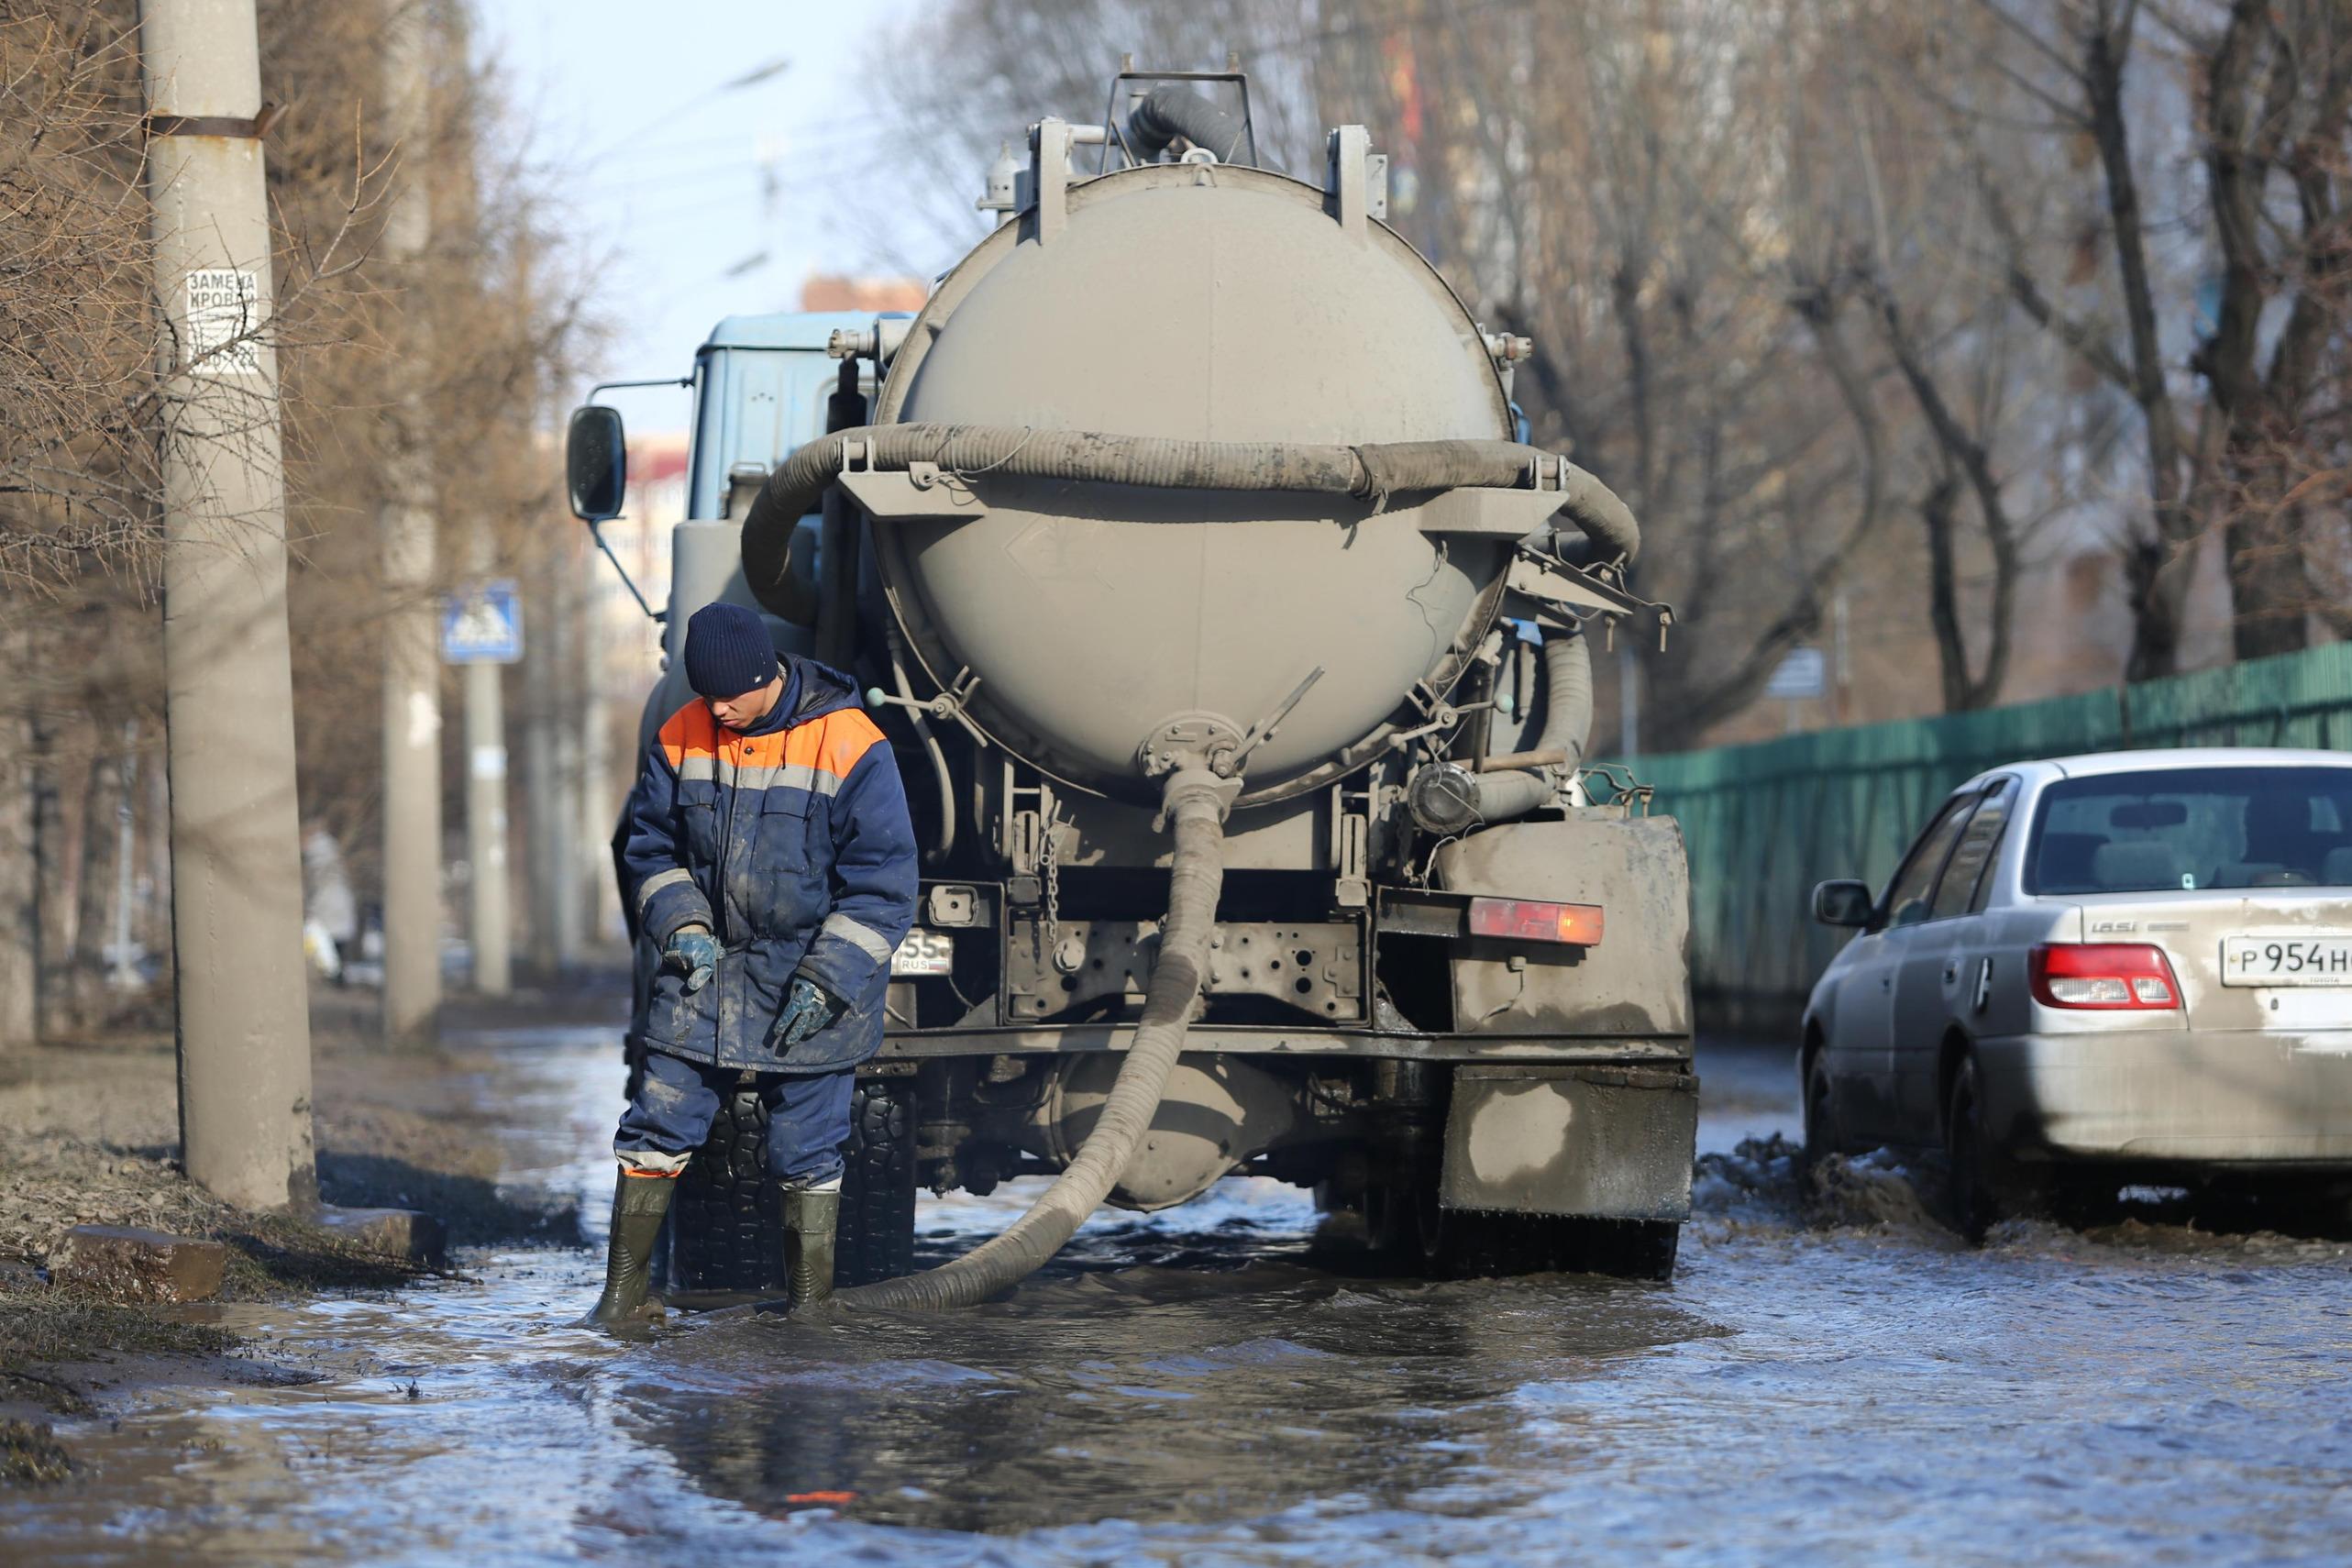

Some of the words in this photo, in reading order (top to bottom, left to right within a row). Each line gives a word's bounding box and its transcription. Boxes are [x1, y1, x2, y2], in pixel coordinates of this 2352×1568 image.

[190, 274, 255, 290] ЗАМЕНА
[905, 933, 937, 958] 55
[901, 960, 927, 969] RUS
[2242, 943, 2352, 972] Р954Н
